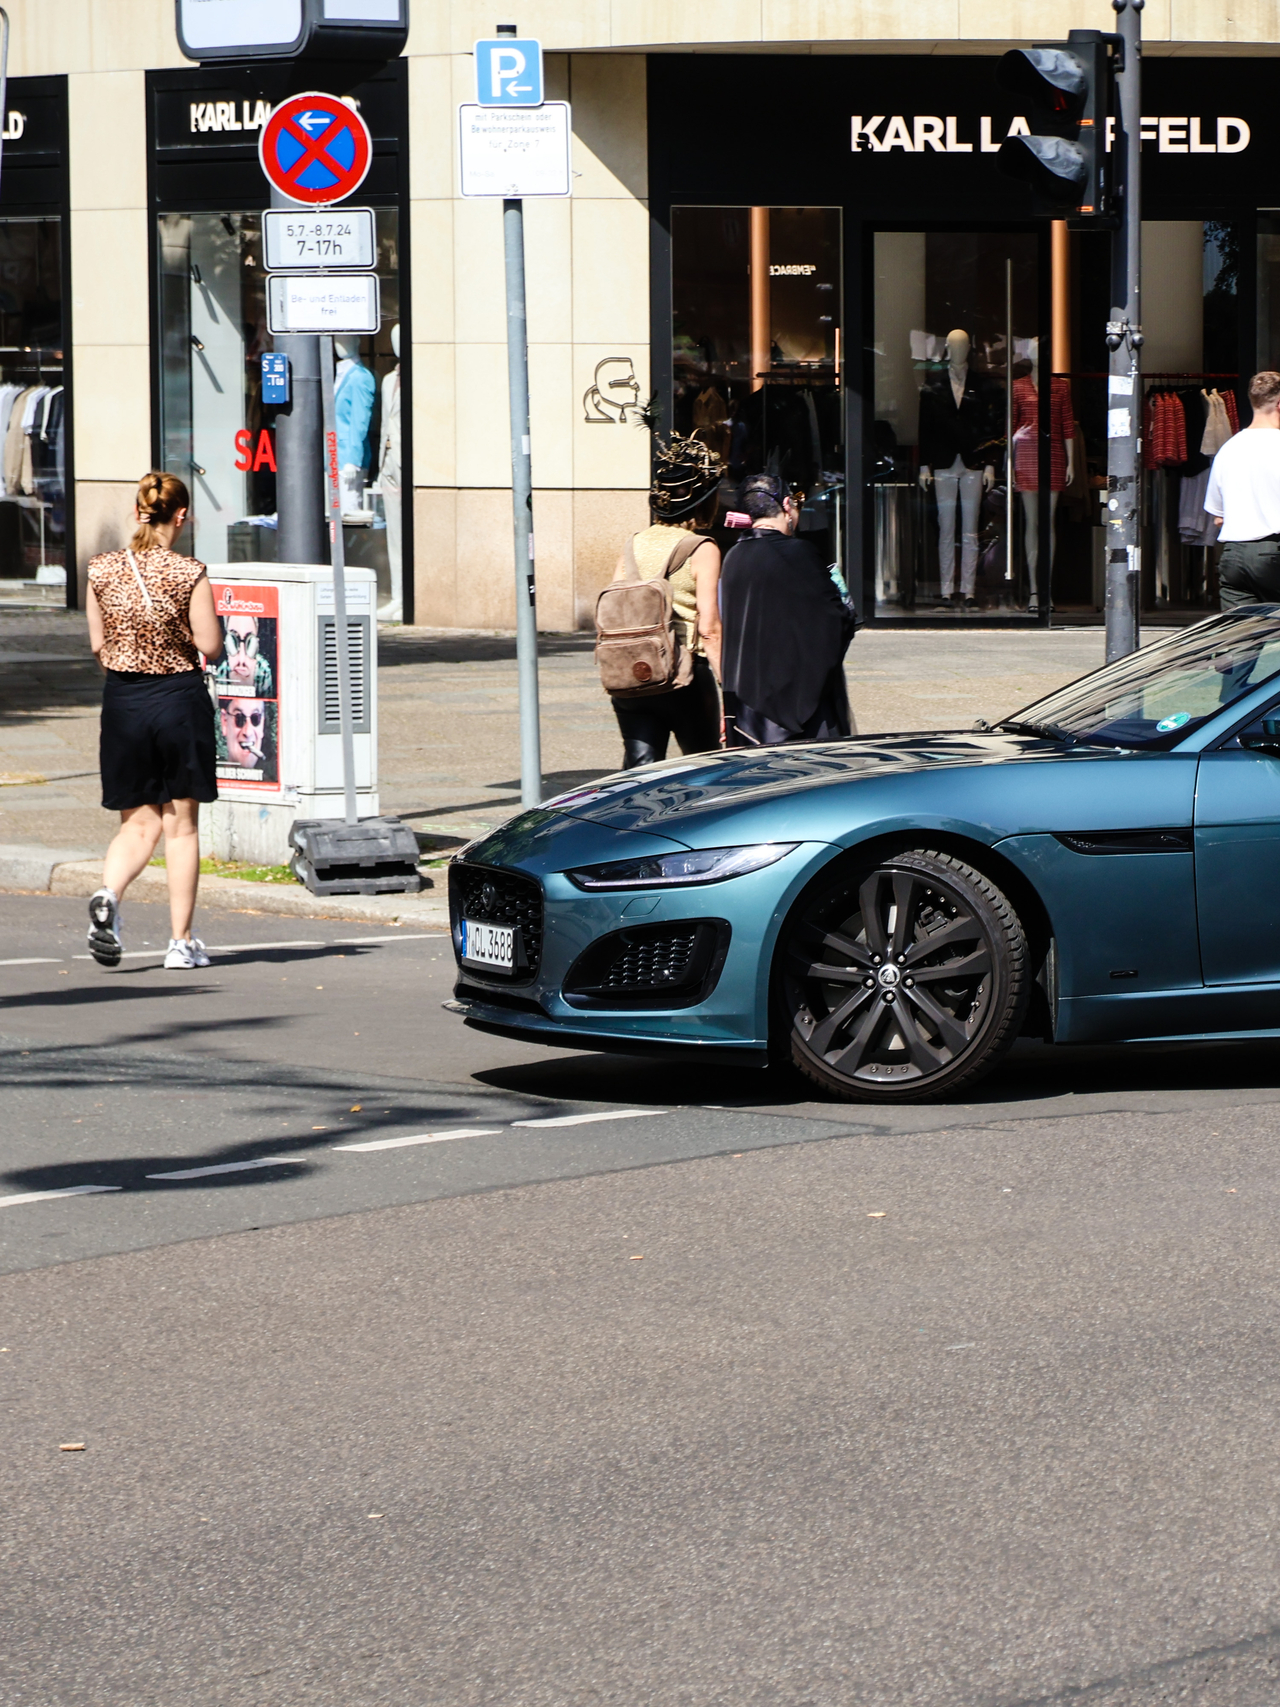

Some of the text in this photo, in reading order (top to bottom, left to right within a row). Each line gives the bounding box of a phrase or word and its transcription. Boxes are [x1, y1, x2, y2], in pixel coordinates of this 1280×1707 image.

[190, 101, 242, 132] KARL
[491, 113, 532, 121] Parkschein
[535, 113, 552, 121] oder
[850, 115, 1251, 153] KARL LAFELD
[507, 140, 531, 148] Zone
[287, 224, 352, 237] 5.7.-8.7.24
[297, 240, 343, 256] 7-17h
[309, 294, 326, 303] und
[328, 294, 367, 303] Entladen
[321, 307, 337, 316] frei
[234, 428, 278, 473] SA
[475, 927, 486, 958] CL
[487, 929, 513, 962] 3688
